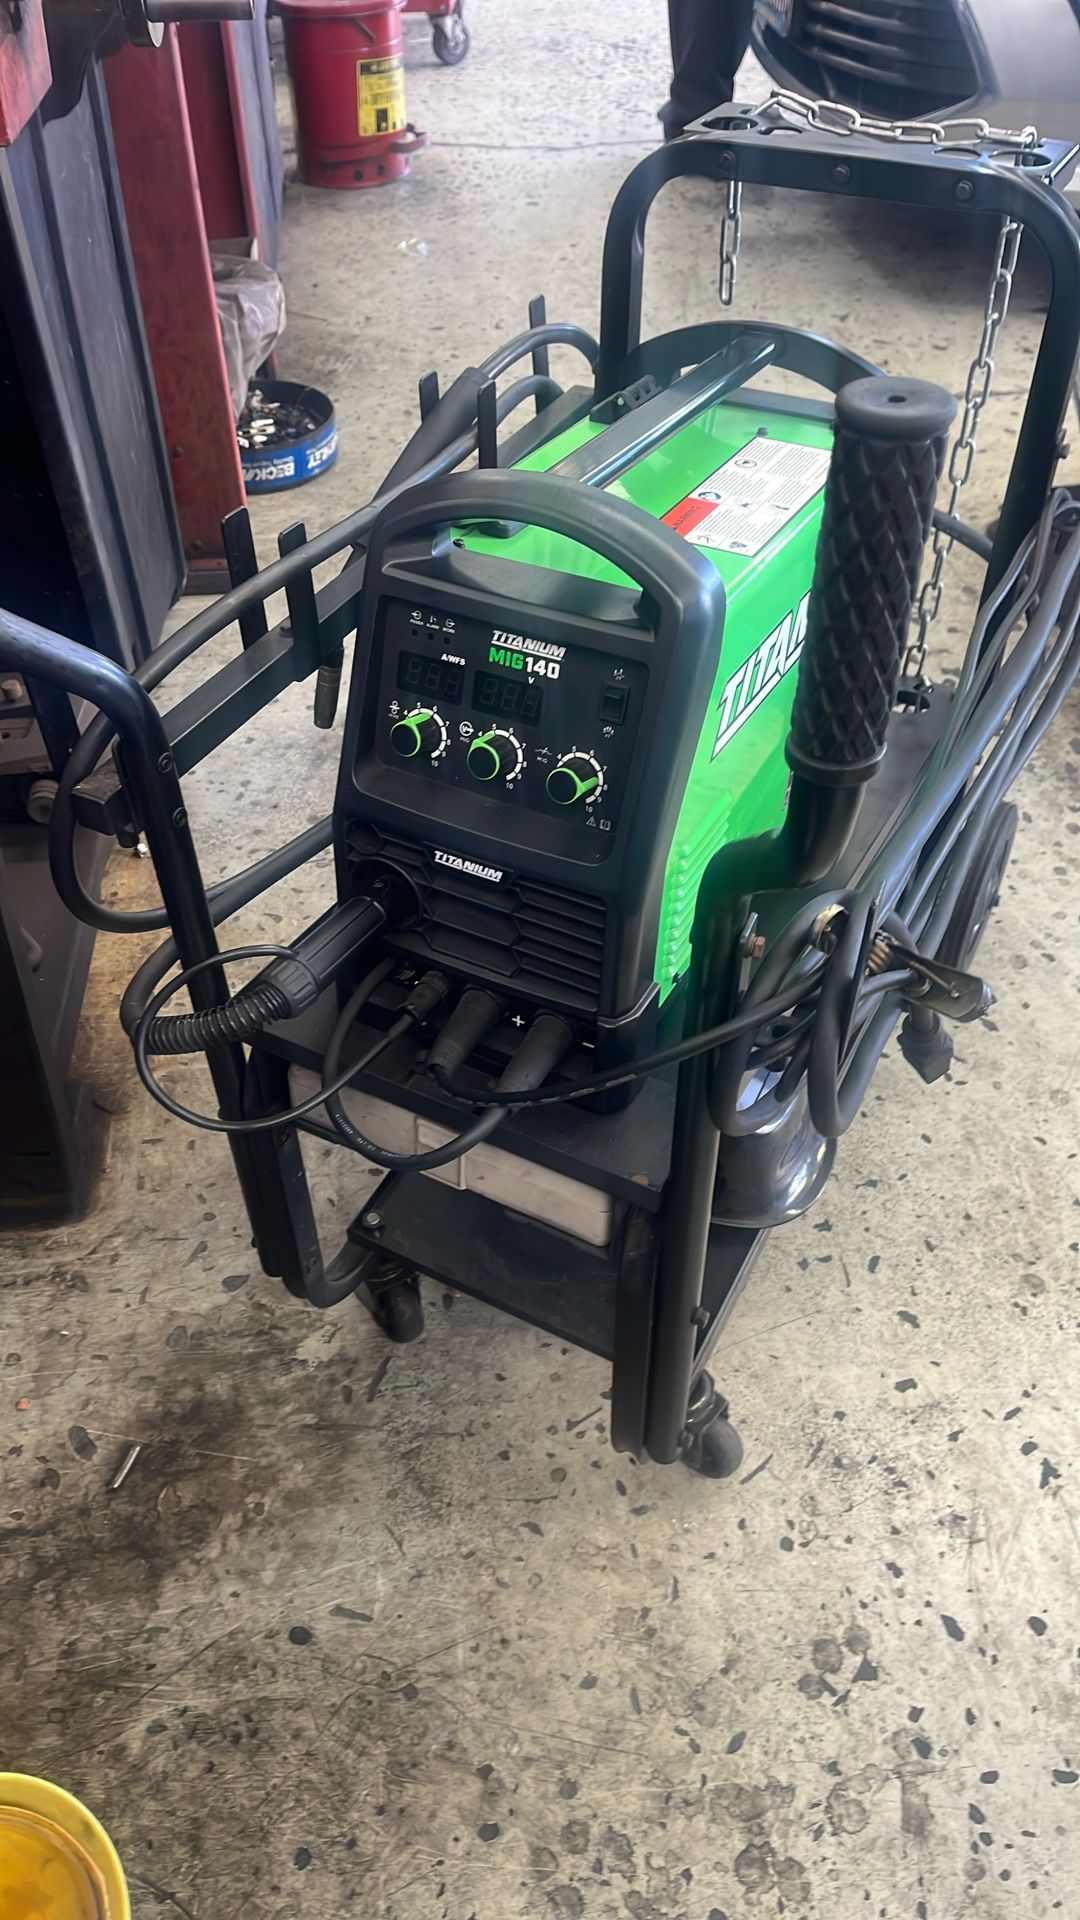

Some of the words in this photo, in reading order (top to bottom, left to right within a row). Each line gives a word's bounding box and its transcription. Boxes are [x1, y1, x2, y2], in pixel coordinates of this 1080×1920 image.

[491, 630, 566, 660] TITANIUM
[506, 782, 514, 790] 10
[585, 805, 593, 813] 10
[434, 850, 503, 881] TITANIUM
